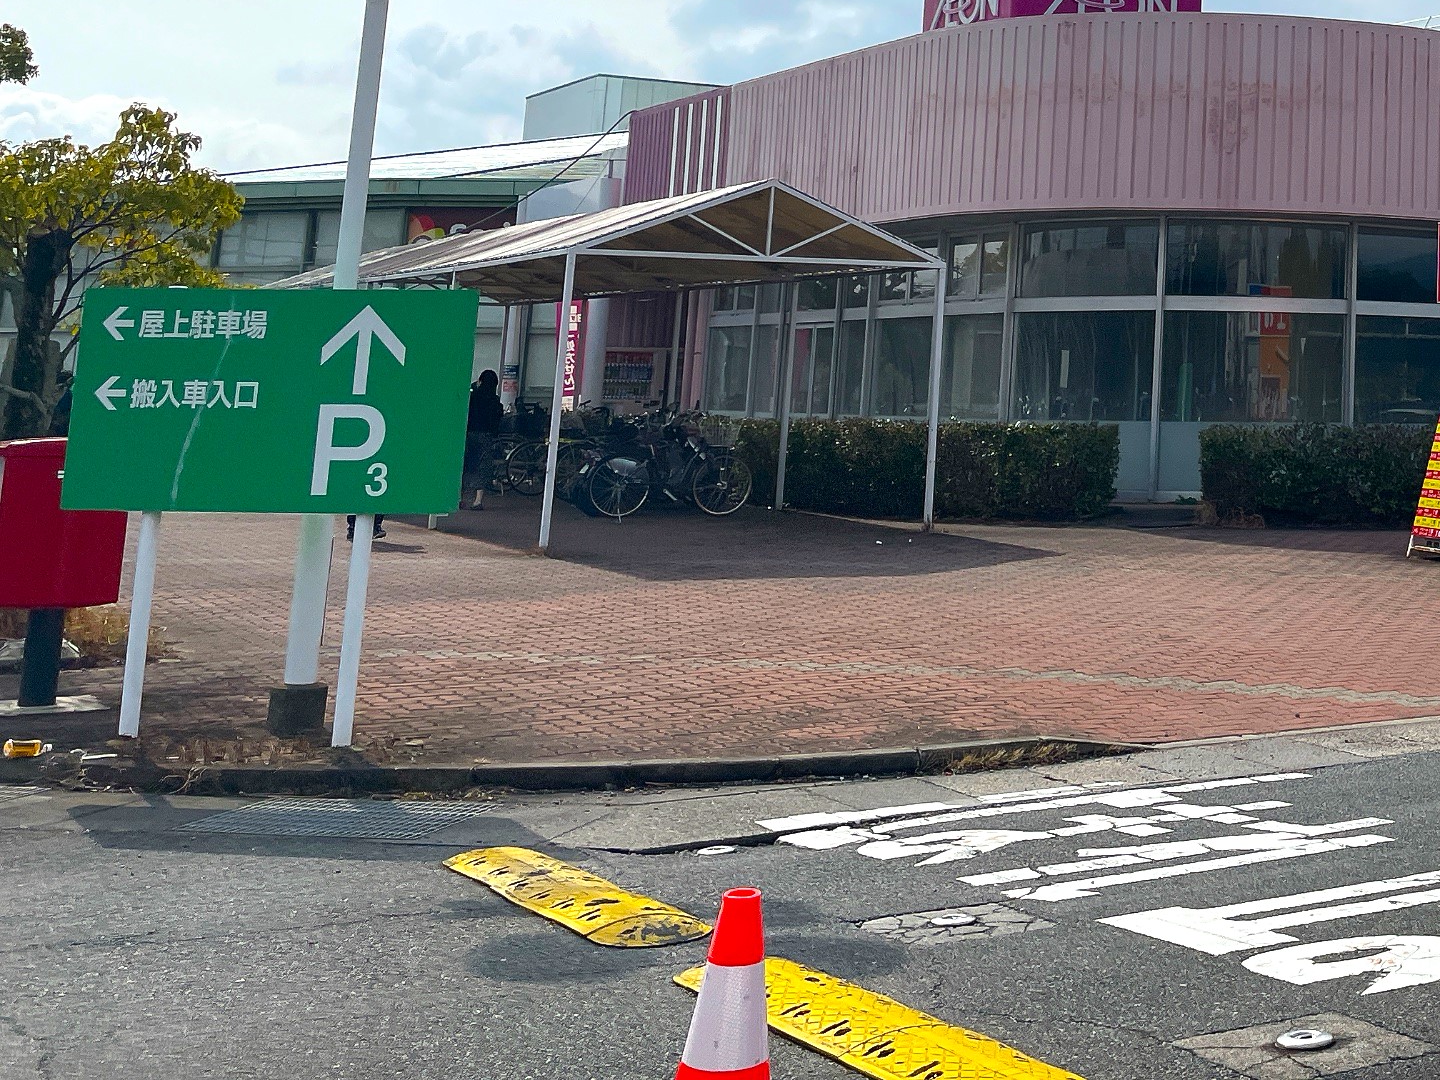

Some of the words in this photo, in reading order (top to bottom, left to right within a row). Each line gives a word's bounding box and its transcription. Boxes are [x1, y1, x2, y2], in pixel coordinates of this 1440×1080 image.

[138, 309, 268, 340] 屋上駐車場
[130, 378, 259, 409] 搬入車入口
